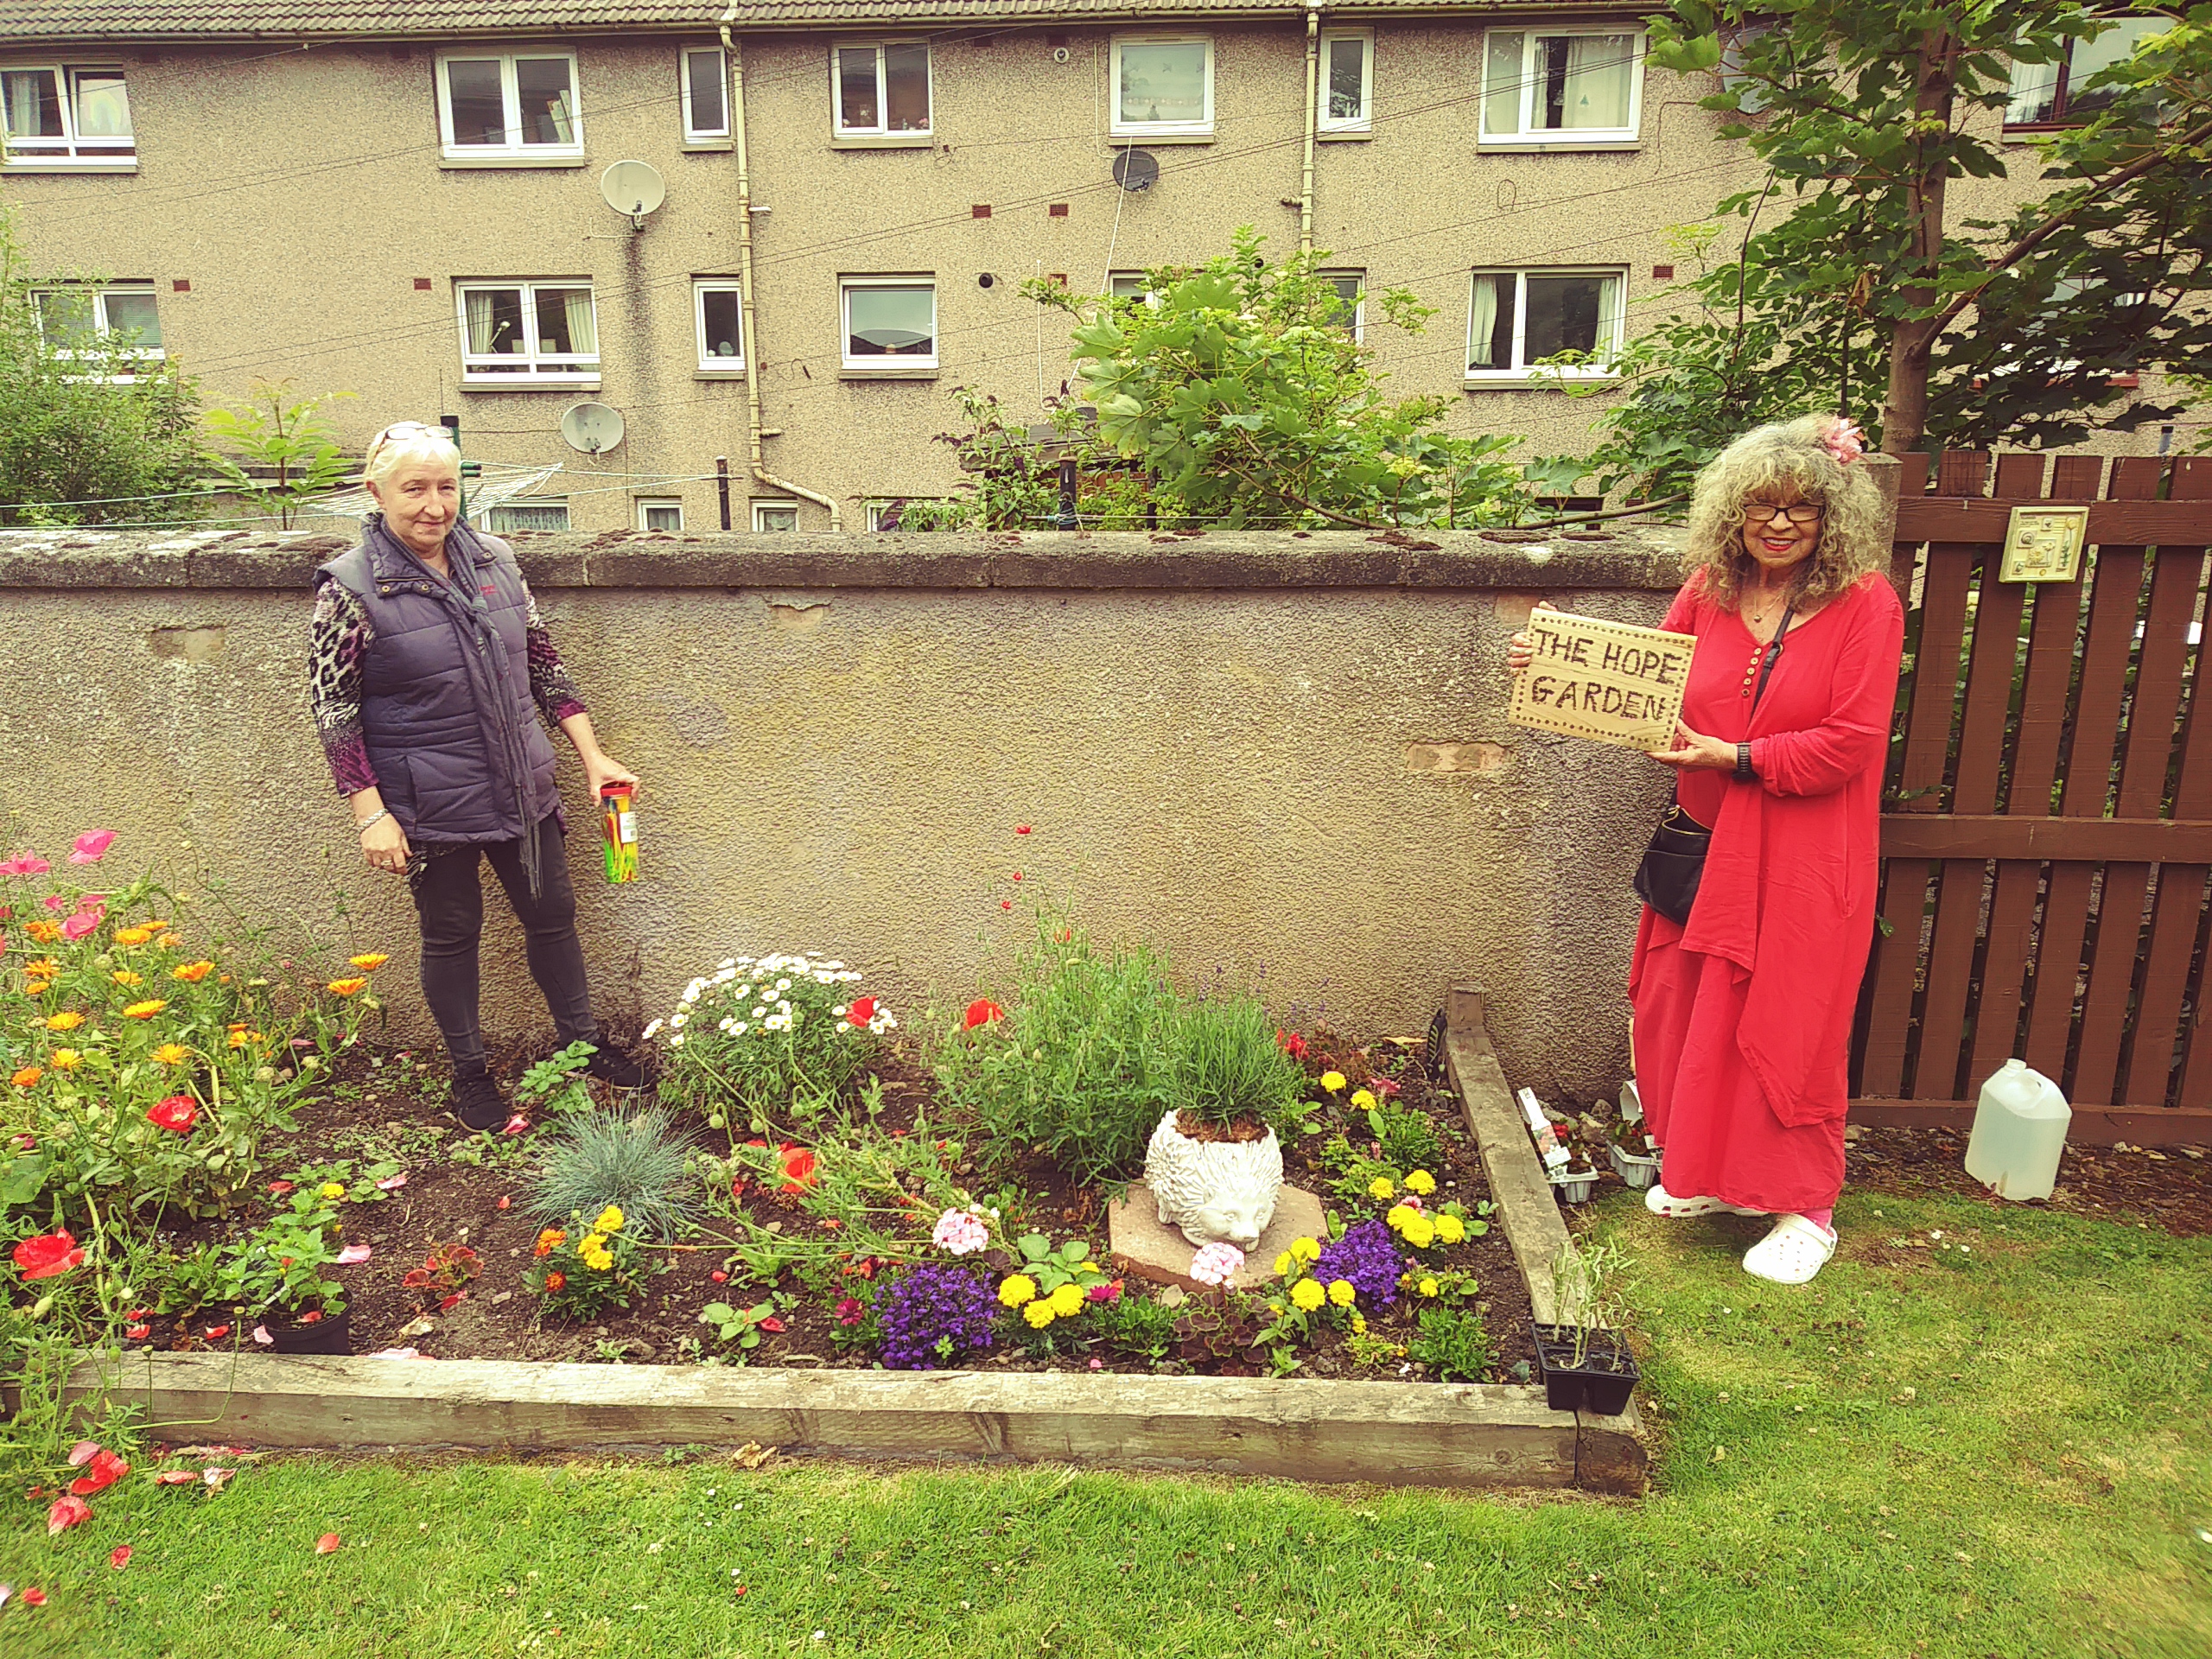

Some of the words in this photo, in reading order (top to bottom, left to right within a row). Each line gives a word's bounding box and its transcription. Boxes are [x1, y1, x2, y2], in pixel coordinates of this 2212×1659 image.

[1535, 628, 1594, 667] THE
[1602, 642, 1683, 684] HOPE
[1531, 676, 1667, 721] GARDEN
